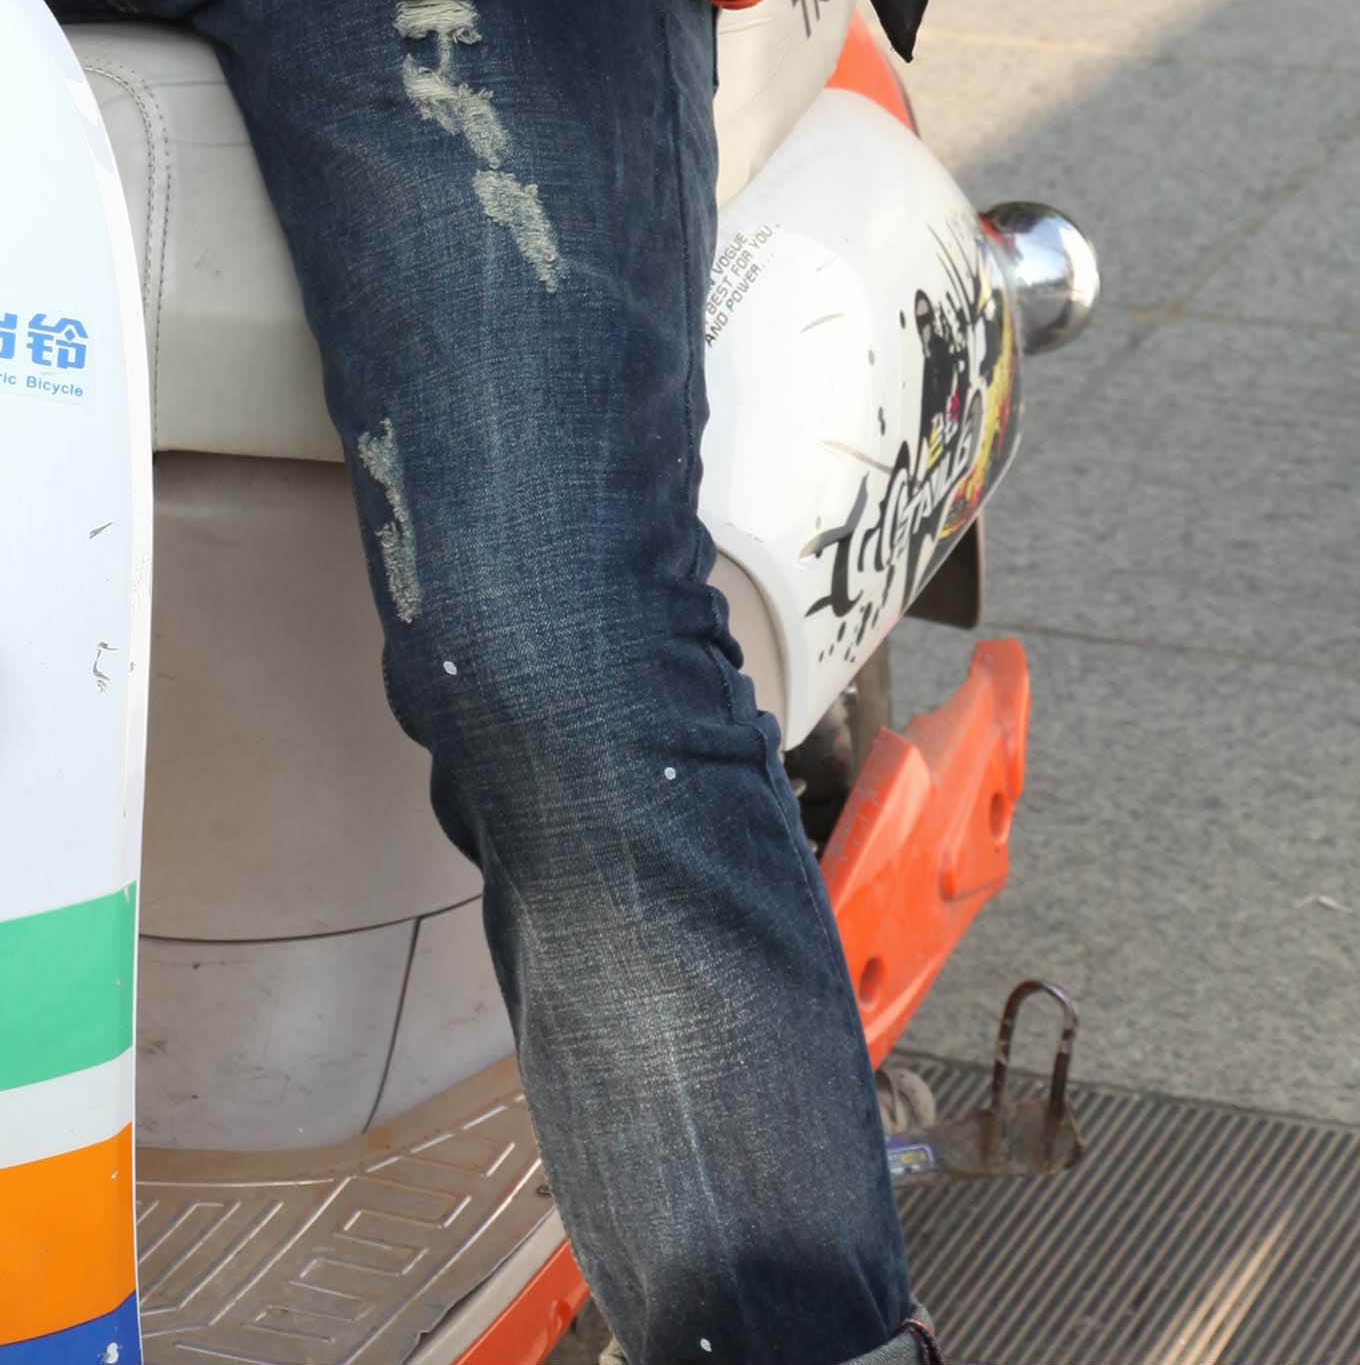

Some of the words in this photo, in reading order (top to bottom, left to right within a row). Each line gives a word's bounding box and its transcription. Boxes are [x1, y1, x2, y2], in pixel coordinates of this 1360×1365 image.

[712, 232, 748, 276] VOGUE
[705, 275, 733, 315] BEST
[730, 250, 753, 277] FOR
[705, 311, 729, 348] AND
[25, 374, 85, 398] Bicycle
